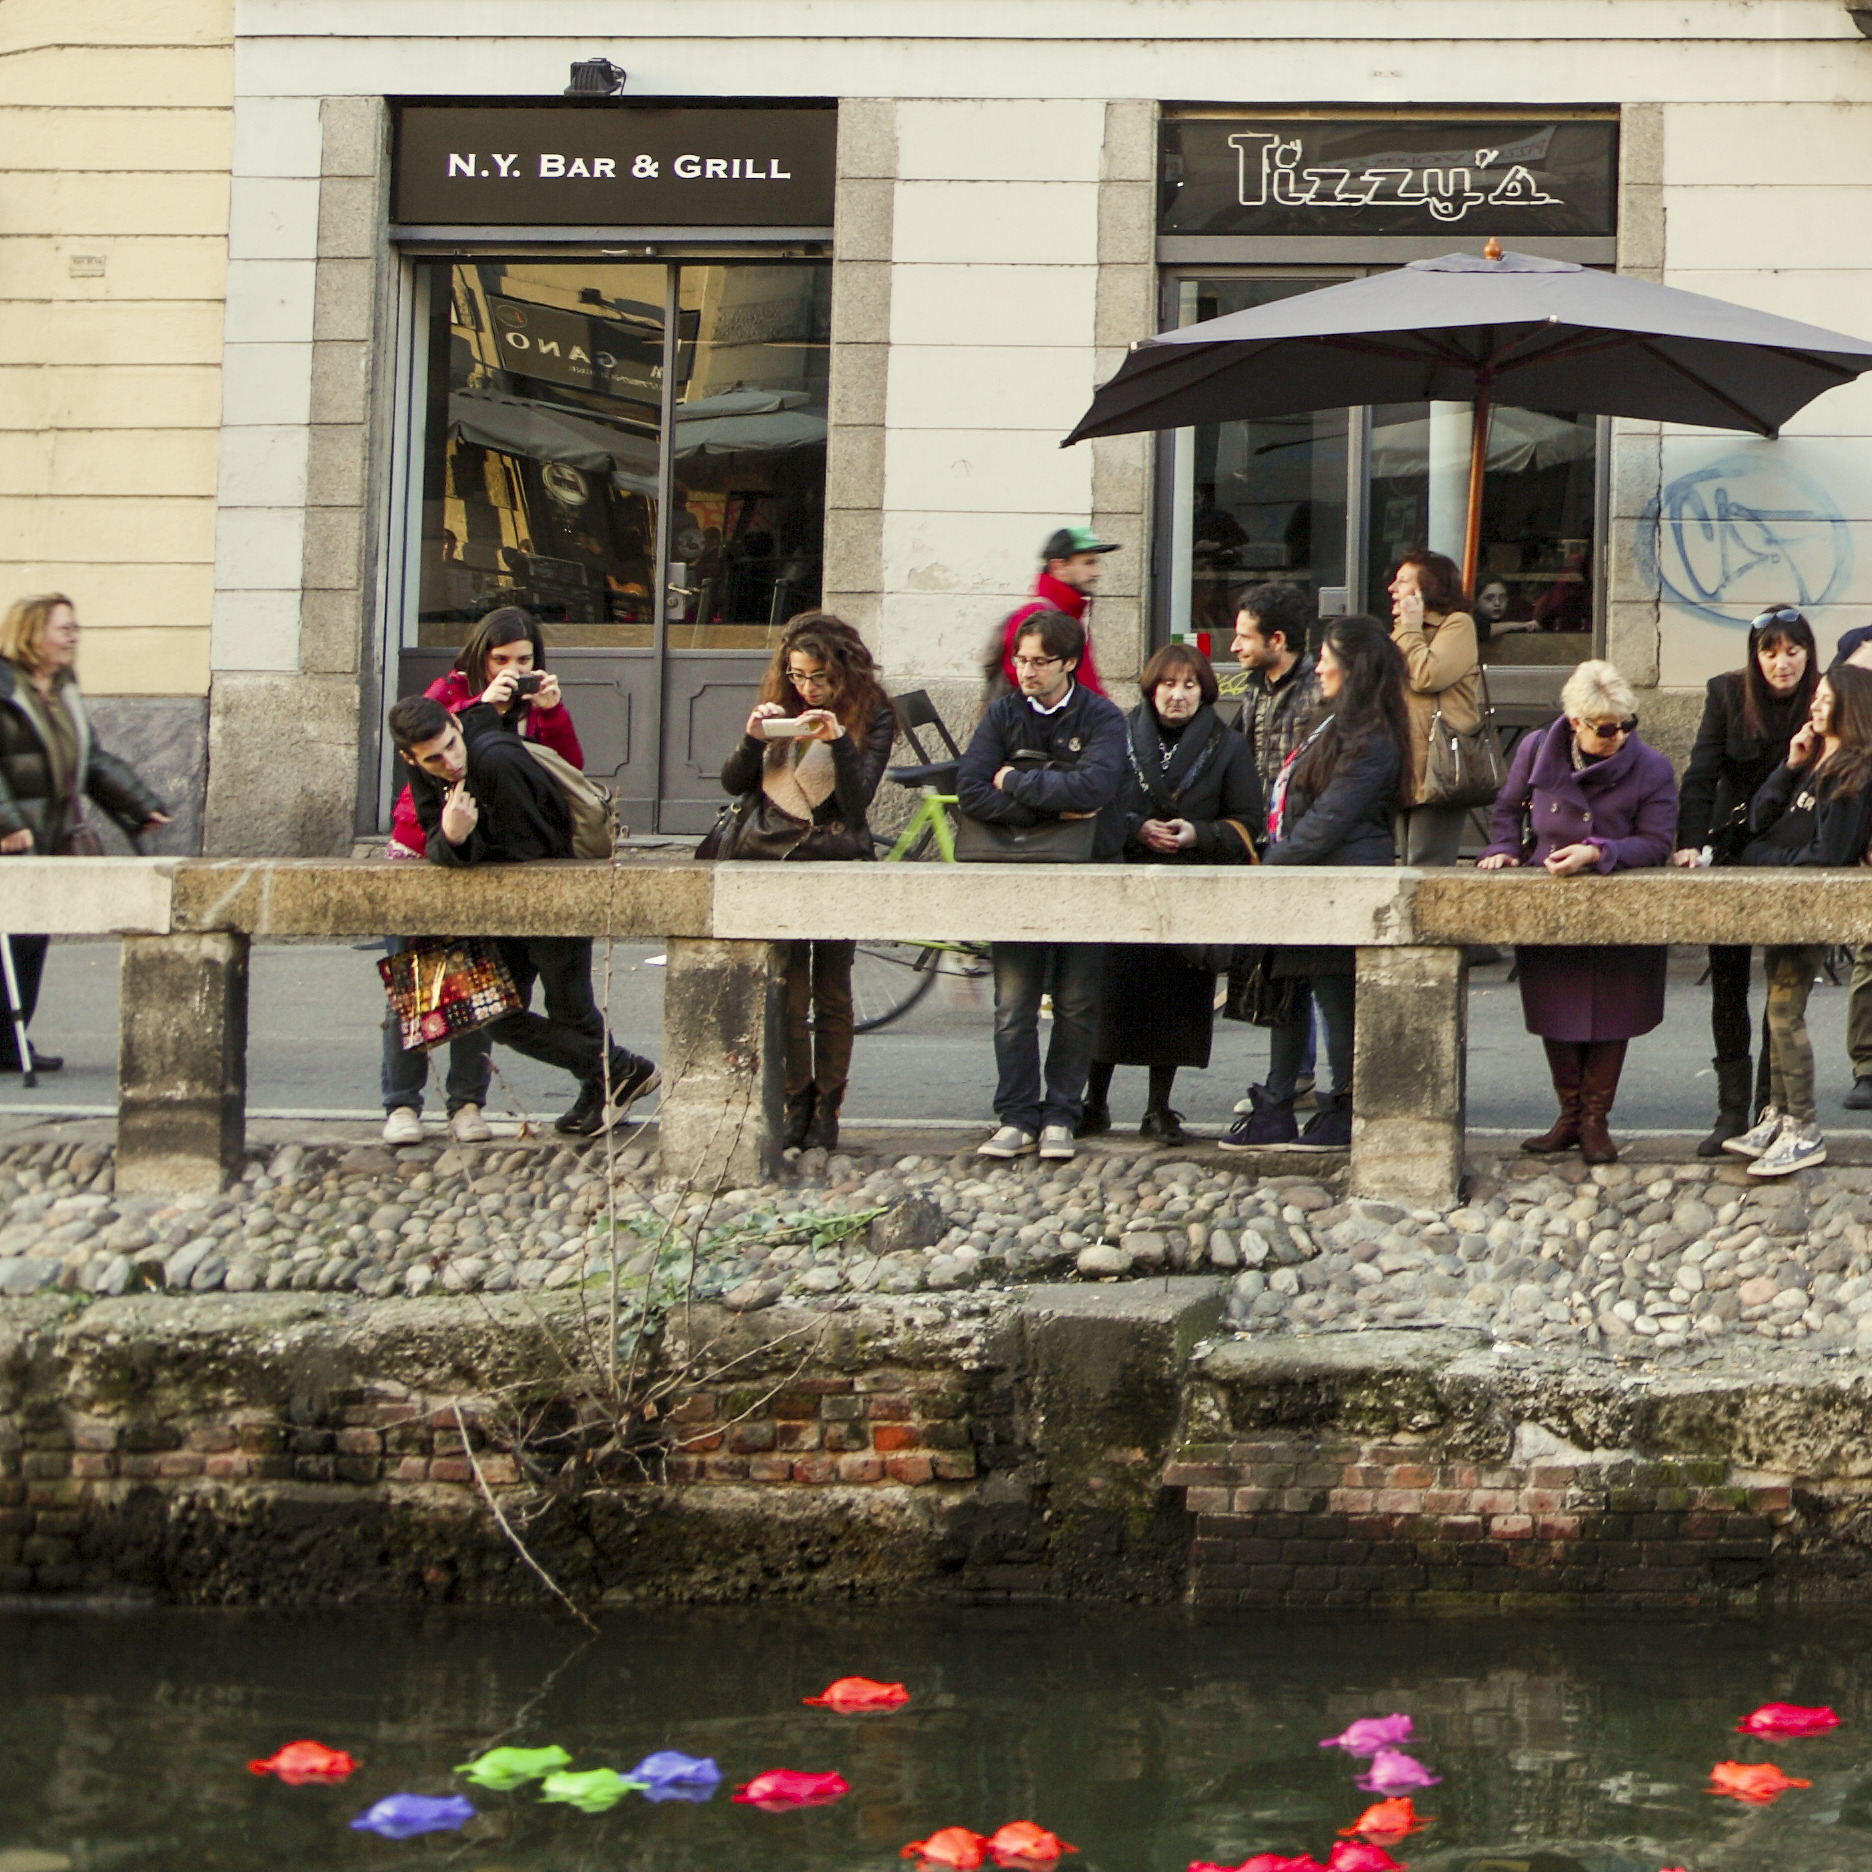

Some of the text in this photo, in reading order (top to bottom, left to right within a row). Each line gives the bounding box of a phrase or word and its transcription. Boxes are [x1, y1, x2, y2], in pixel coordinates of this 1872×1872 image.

[448, 152, 520, 179] N.Y.
[631, 153, 659, 179] &
[1227, 130, 1564, 222] Tizzy's
